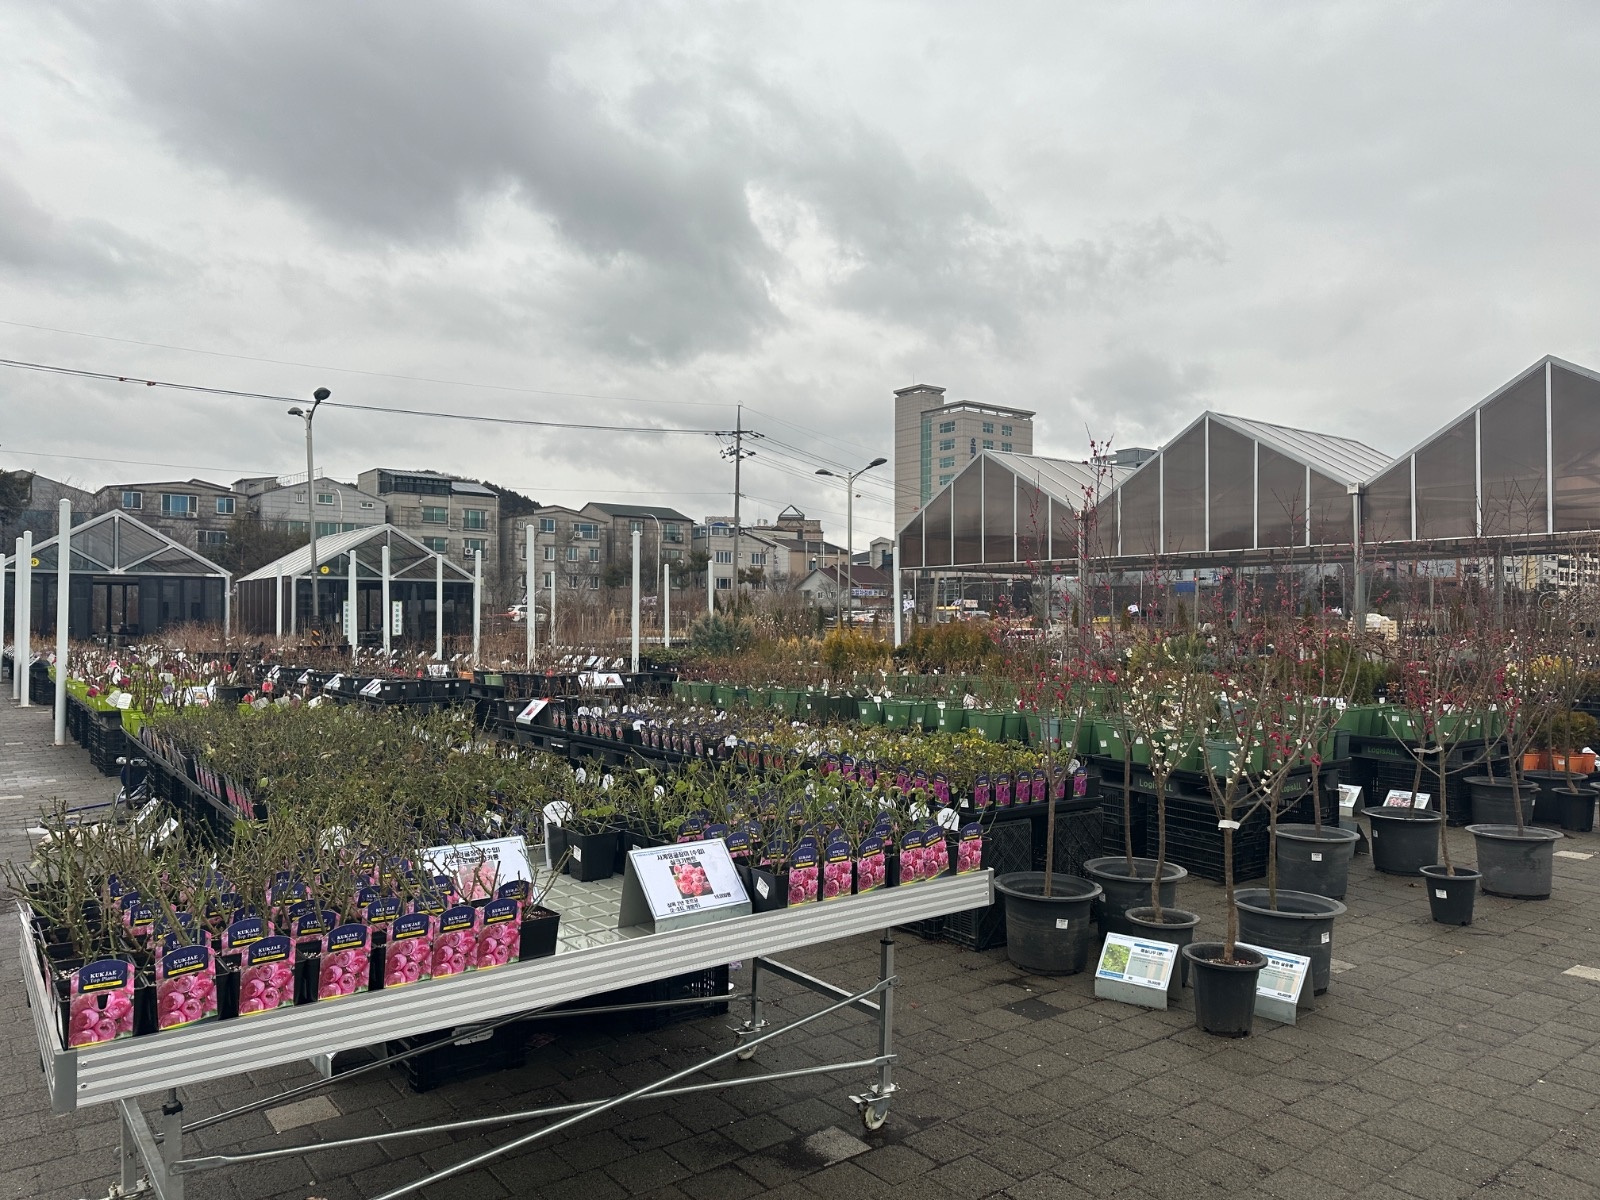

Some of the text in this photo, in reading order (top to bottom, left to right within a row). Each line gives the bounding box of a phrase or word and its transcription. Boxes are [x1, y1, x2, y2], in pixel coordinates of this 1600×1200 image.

[1367, 746, 1400, 756] LogisALL
[1139, 779, 1174, 792] LogisLL
[258, 944, 281, 953] KUKJAE
[173, 954, 198, 964] KUKJAE
[90, 970, 117, 979] KUKJAE
[102, 975, 117, 983] Plants
